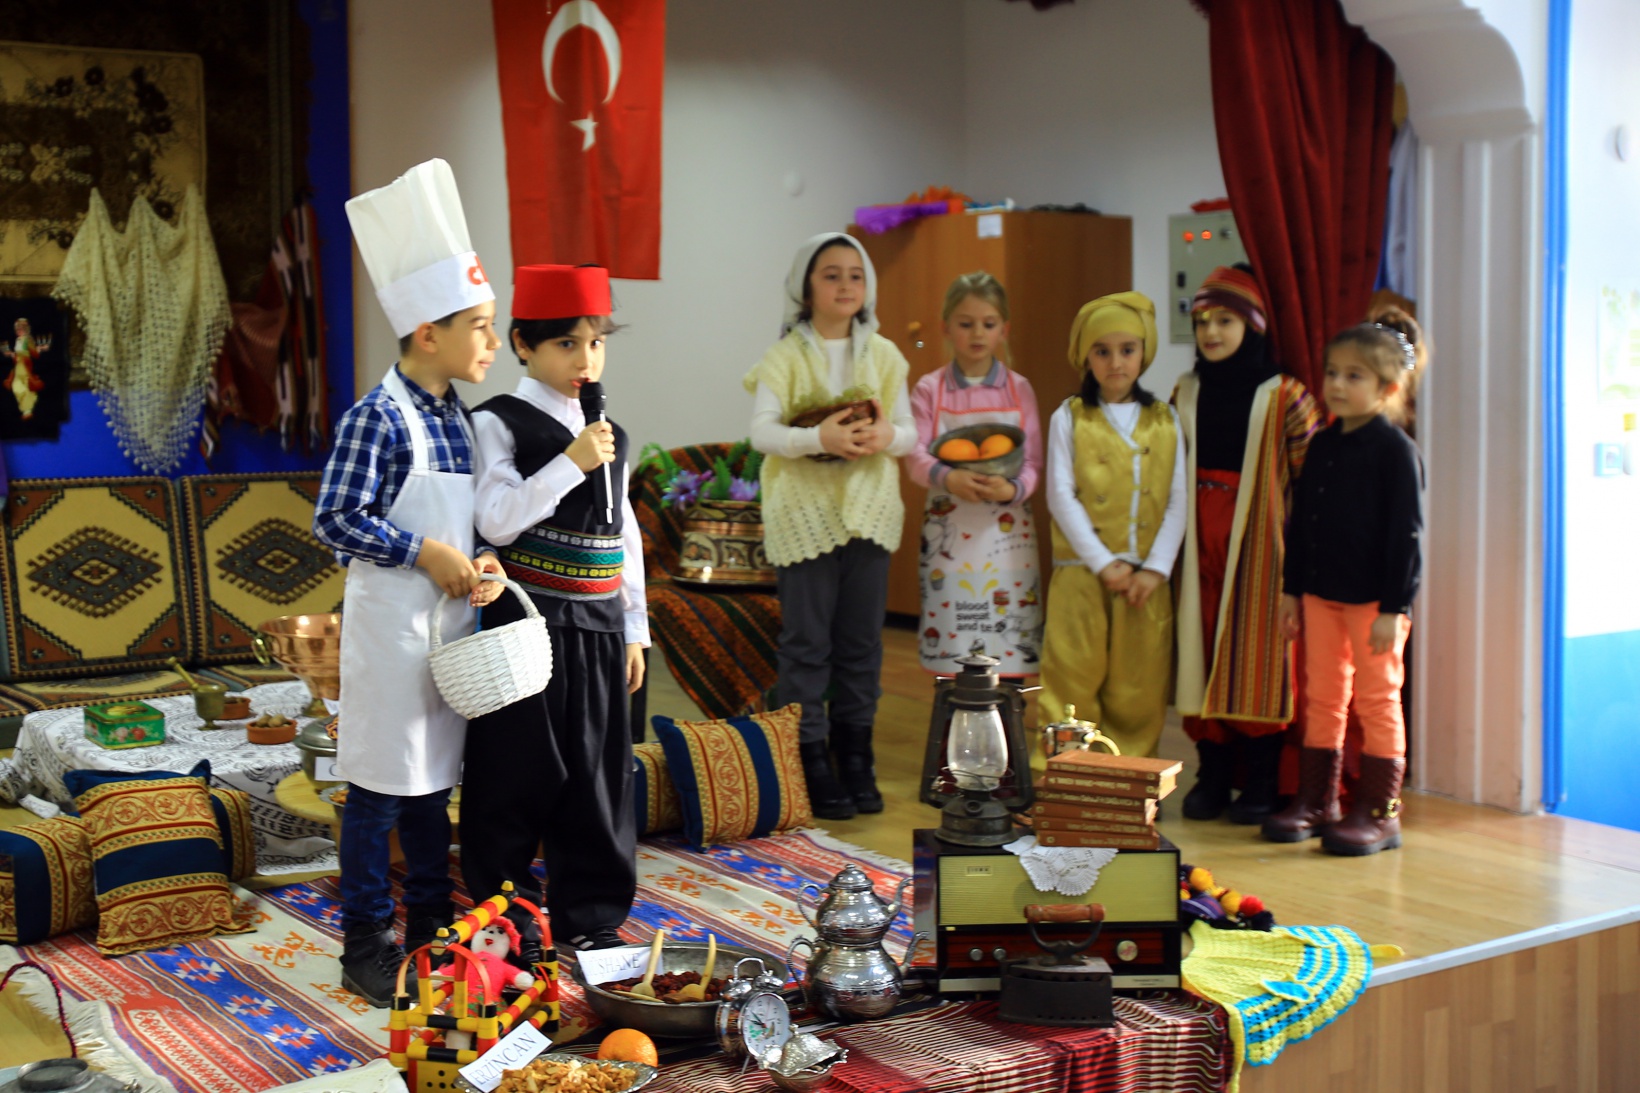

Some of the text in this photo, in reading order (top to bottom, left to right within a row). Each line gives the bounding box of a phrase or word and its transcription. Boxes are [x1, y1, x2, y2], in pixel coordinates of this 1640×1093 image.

[955, 600, 989, 610] blood
[956, 612, 990, 620] sweat
[956, 621, 978, 631] and
[468, 1032, 536, 1085] ERZİNCAN
